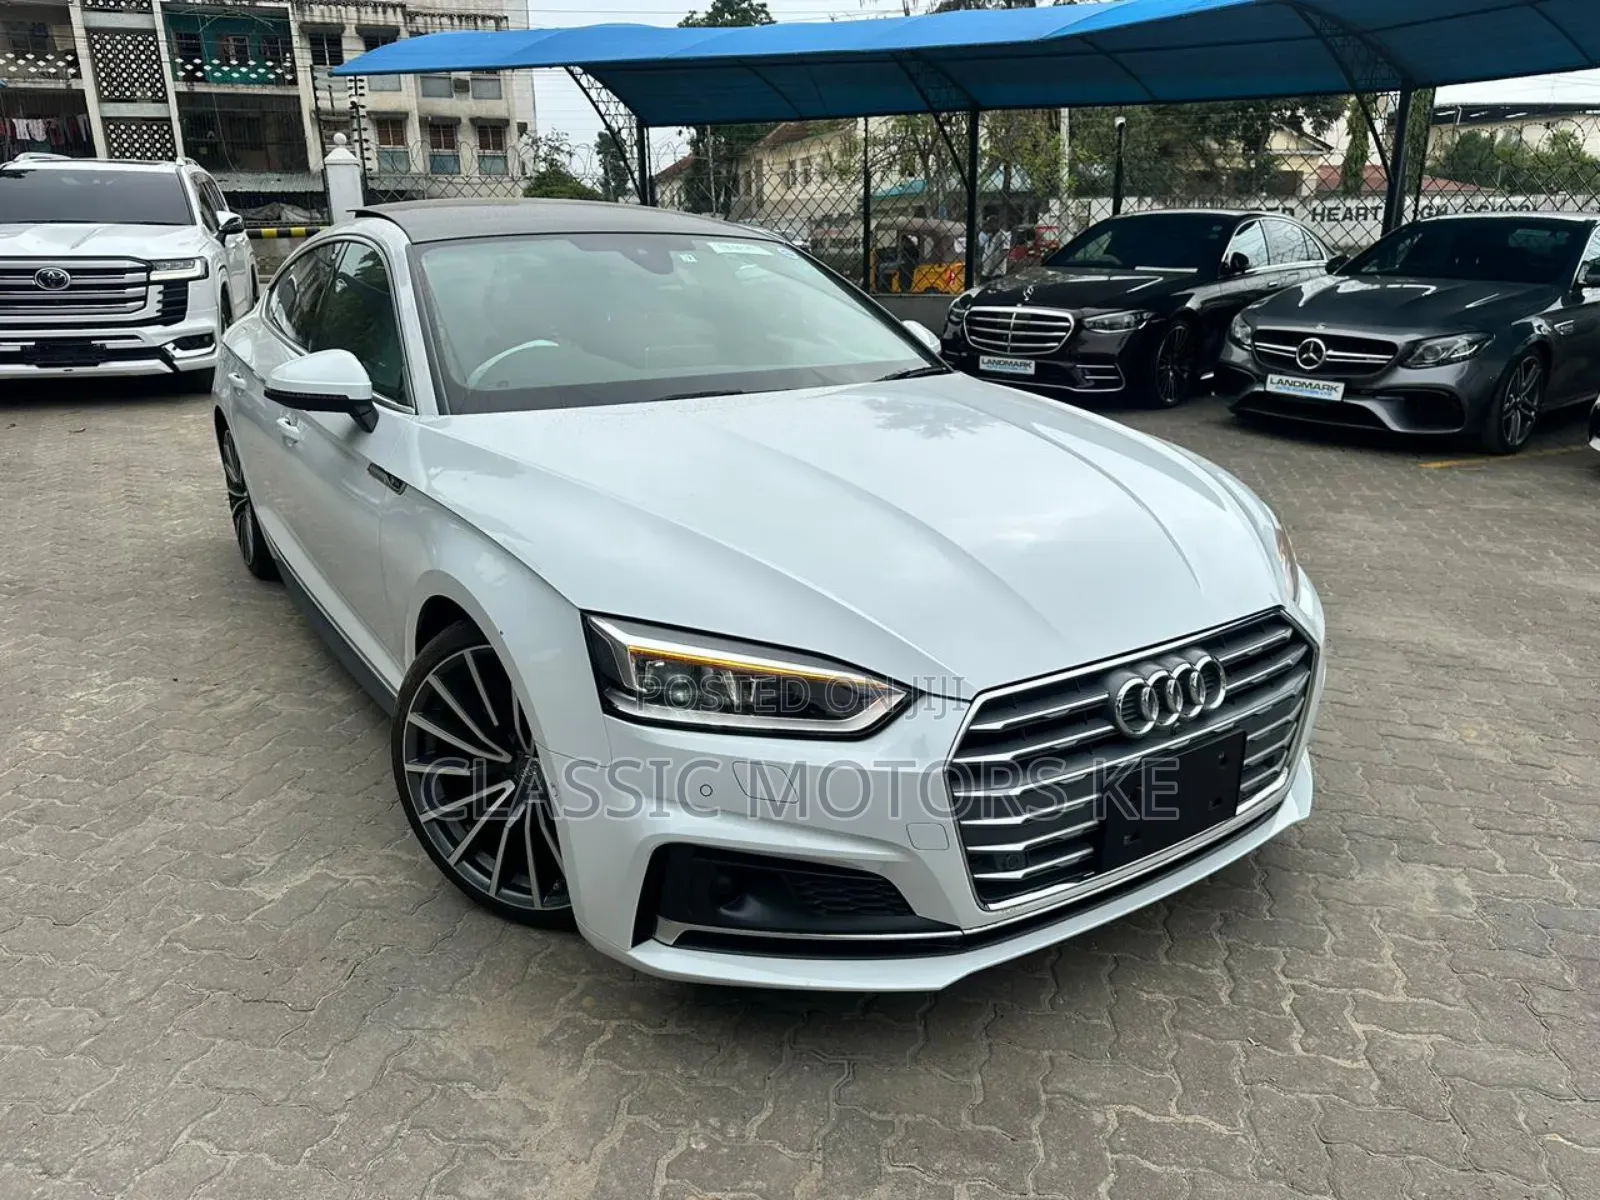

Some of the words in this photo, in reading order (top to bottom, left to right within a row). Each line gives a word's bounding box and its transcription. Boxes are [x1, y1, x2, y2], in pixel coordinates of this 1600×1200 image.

[1311, 206, 1383, 222] HEART
[981, 358, 1033, 369] LANDMARK
[1269, 377, 1340, 393] LANDMARK
